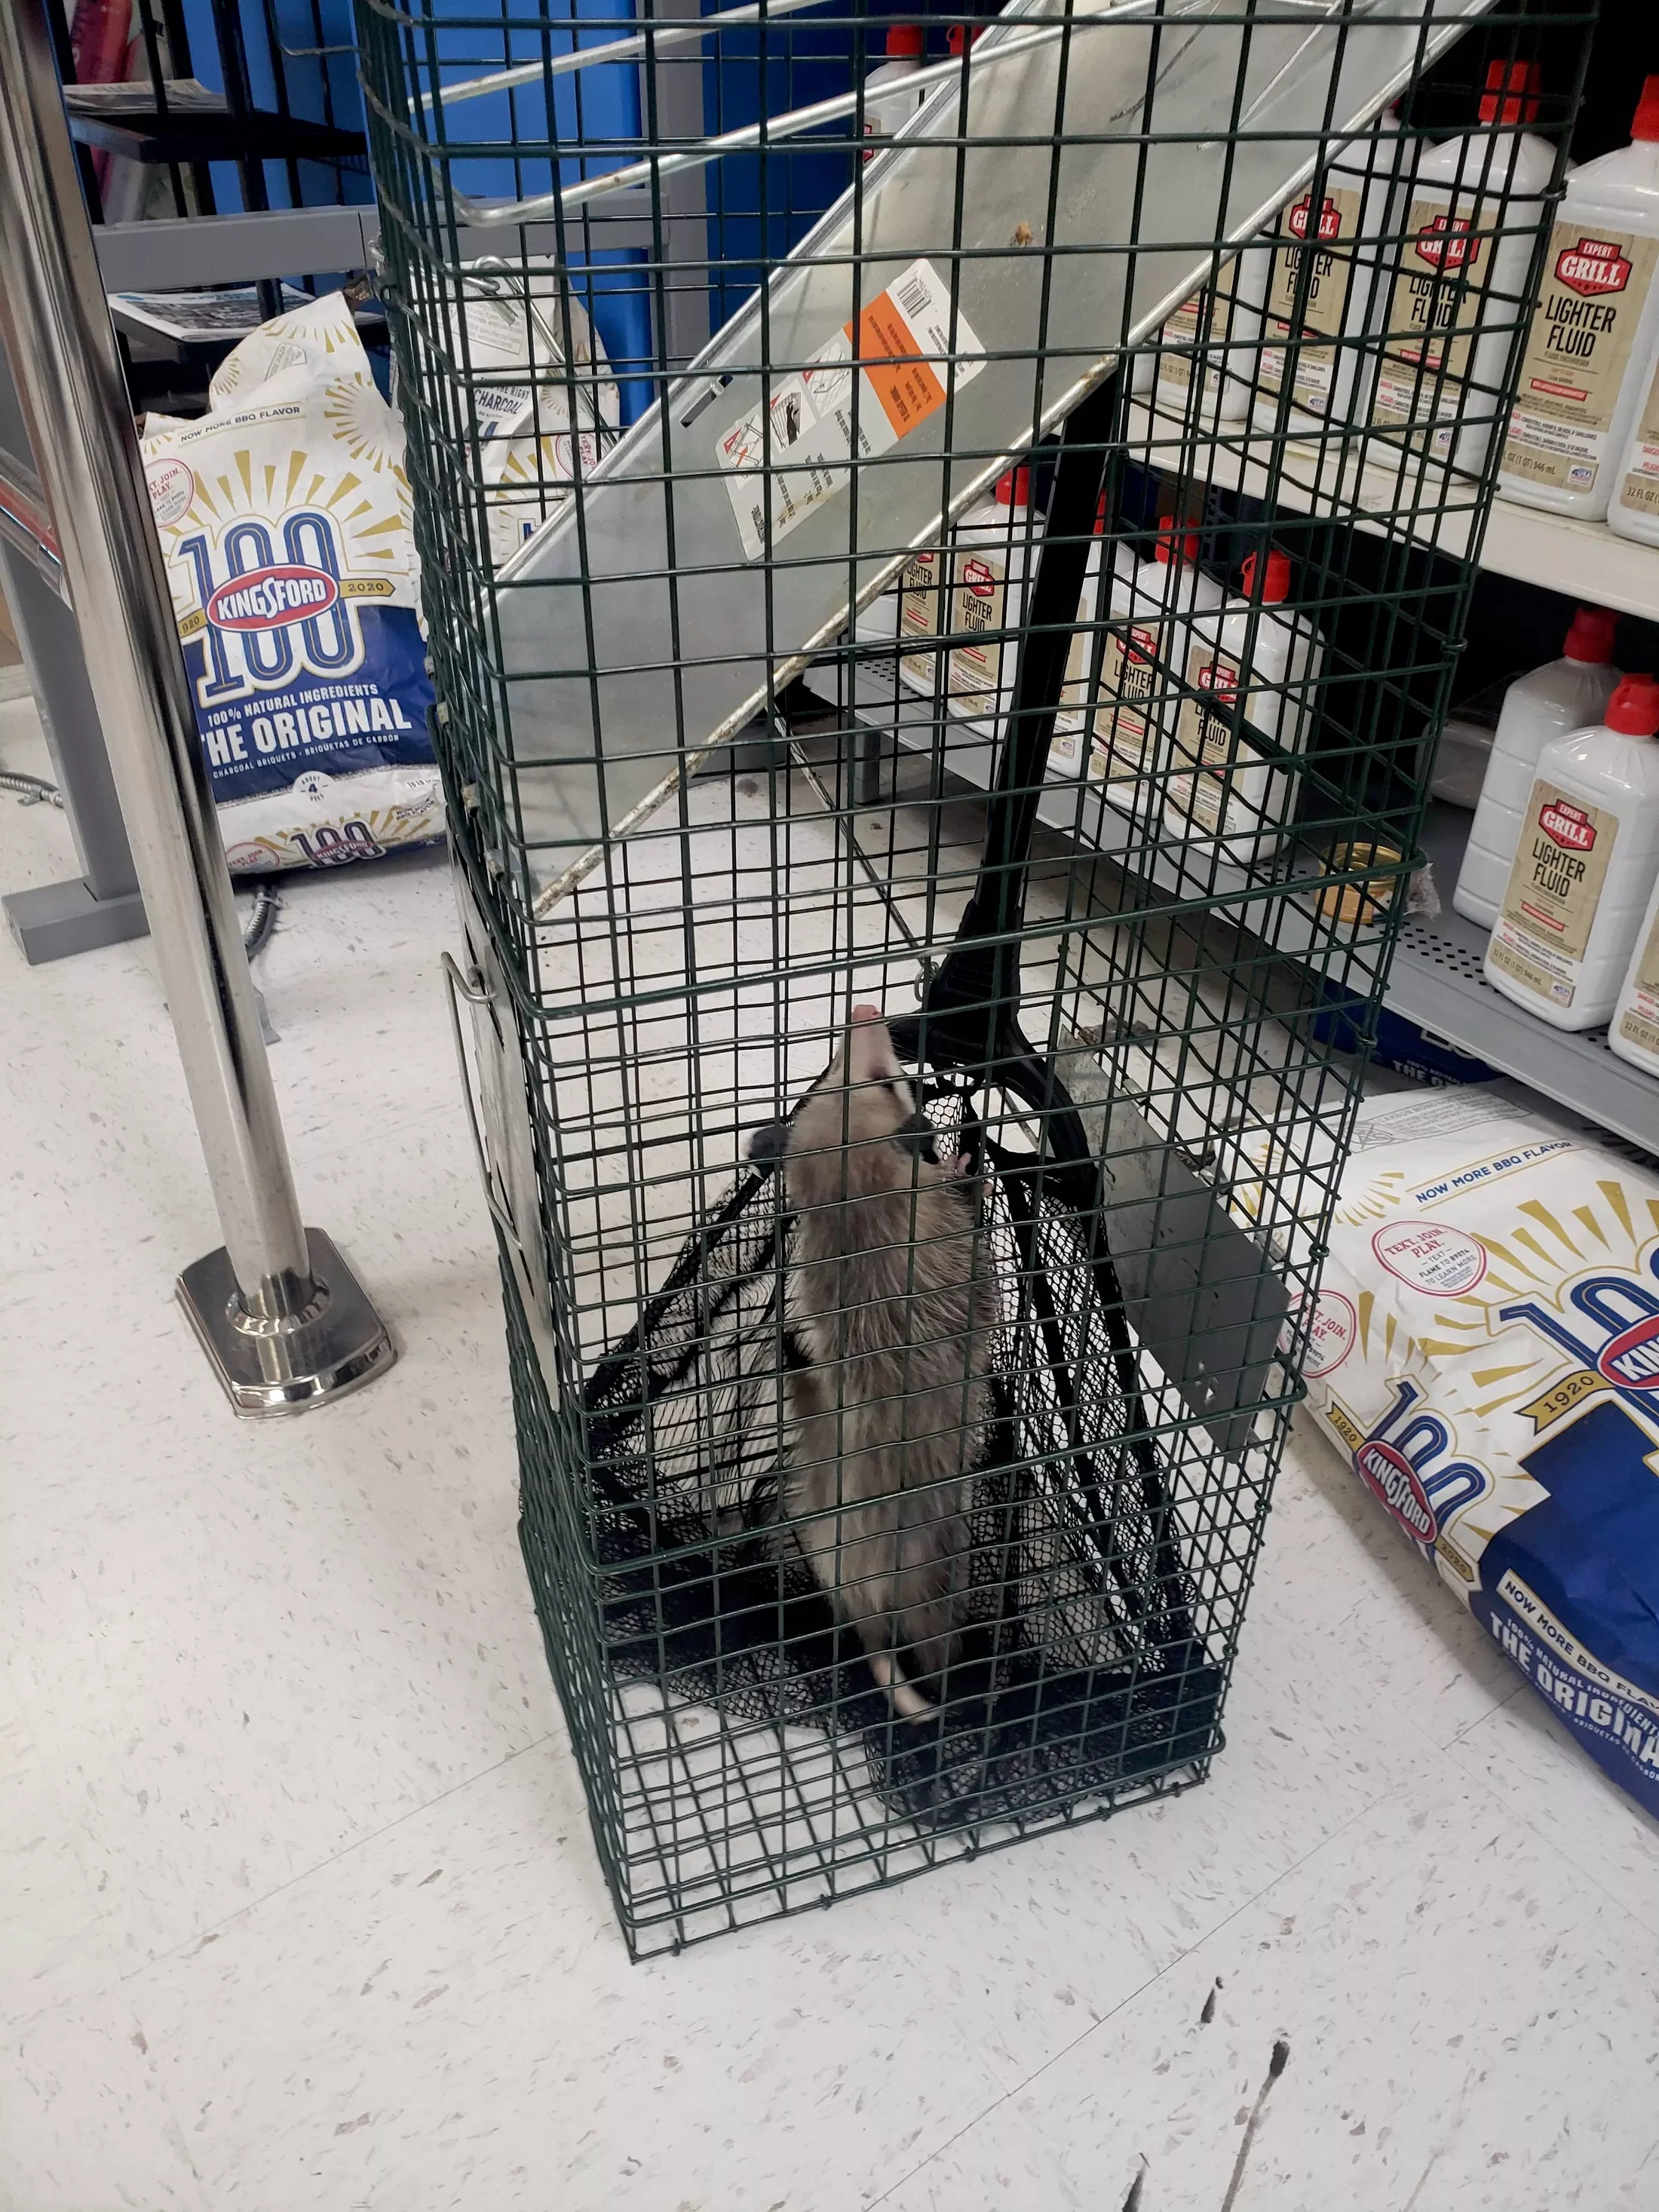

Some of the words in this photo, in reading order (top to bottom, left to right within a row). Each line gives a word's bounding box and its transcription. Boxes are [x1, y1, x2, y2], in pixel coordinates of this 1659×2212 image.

[1582, 241, 1613, 258] EXPERT
[1560, 254, 1621, 287] GRILL
[1411, 298, 1452, 328] FLID
[1545, 295, 1617, 333] LIGHTER
[1547, 326, 1596, 357] FLUID
[474, 388, 523, 415] CHARCOAL
[180, 428, 202, 443] NOW
[204, 419, 232, 432] MORE
[234, 413, 257, 425] BBQ
[259, 406, 300, 419] FLAVOR
[152, 481, 173, 500] PLAY.
[216, 575, 327, 621] KINGSFORD
[348, 581, 384, 593] 2020
[178, 512, 355, 698] 100
[962, 592, 992, 622] LIGHTER
[181, 615, 200, 635] 920
[964, 612, 986, 631] FLUID
[207, 707, 241, 729] 100%
[244, 692, 298, 718] NATURAL
[300, 683, 379, 705] INGREDIENTS
[252, 698, 412, 754] ORIGINAL
[213, 762, 255, 780] CHARCOAL
[257, 752, 297, 769] BRIQUETS
[305, 739, 351, 756] BRIQUETAS
[352, 737, 364, 747] DE
[308, 783, 318, 793] 4
[1542, 811, 1588, 846] GRILL
[1558, 804, 1583, 823] EXPERT
[290, 821, 382, 867] 100
[1532, 838, 1586, 883] LIGHTER
[1533, 863, 1571, 897] FLUID
[1393, 1060, 1427, 1081] THE
[1415, 1183, 1449, 1204] NOW
[1452, 1167, 1492, 1189] MORE
[1493, 1156, 1523, 1172] BBQ
[1524, 1141, 1574, 1161] FLAVOR
[1385, 1238, 1419, 1256] TEXT.
[1417, 1228, 1448, 1243] JOIN.
[1410, 1239, 1446, 1259] PLAY.
[1428, 1250, 1446, 1262] TEXT
[1418, 1263, 1443, 1279] FLAME
[1442, 1259, 1451, 1267] TO
[1425, 1278, 1436, 1287] TO
[1436, 1266, 1458, 1282] LEARN
[1457, 1254, 1478, 1269] MORE
[1322, 1318, 1347, 1341] JOIN.
[1543, 1376, 1595, 1413] 1920
[1333, 1415, 1357, 1443] 1920
[1362, 1448, 1431, 1534] KINGSFORD
[1441, 1545, 1467, 1574] 2020
[1504, 1580, 1536, 1613] NOW
[1537, 1614, 1575, 1655] MORE
[1577, 1654, 1610, 1683] BBQ
[1535, 1647, 1584, 1689] NATURAL
[1490, 1611, 1533, 1672] THE
[1536, 1663, 1659, 1769] ORIGINA
